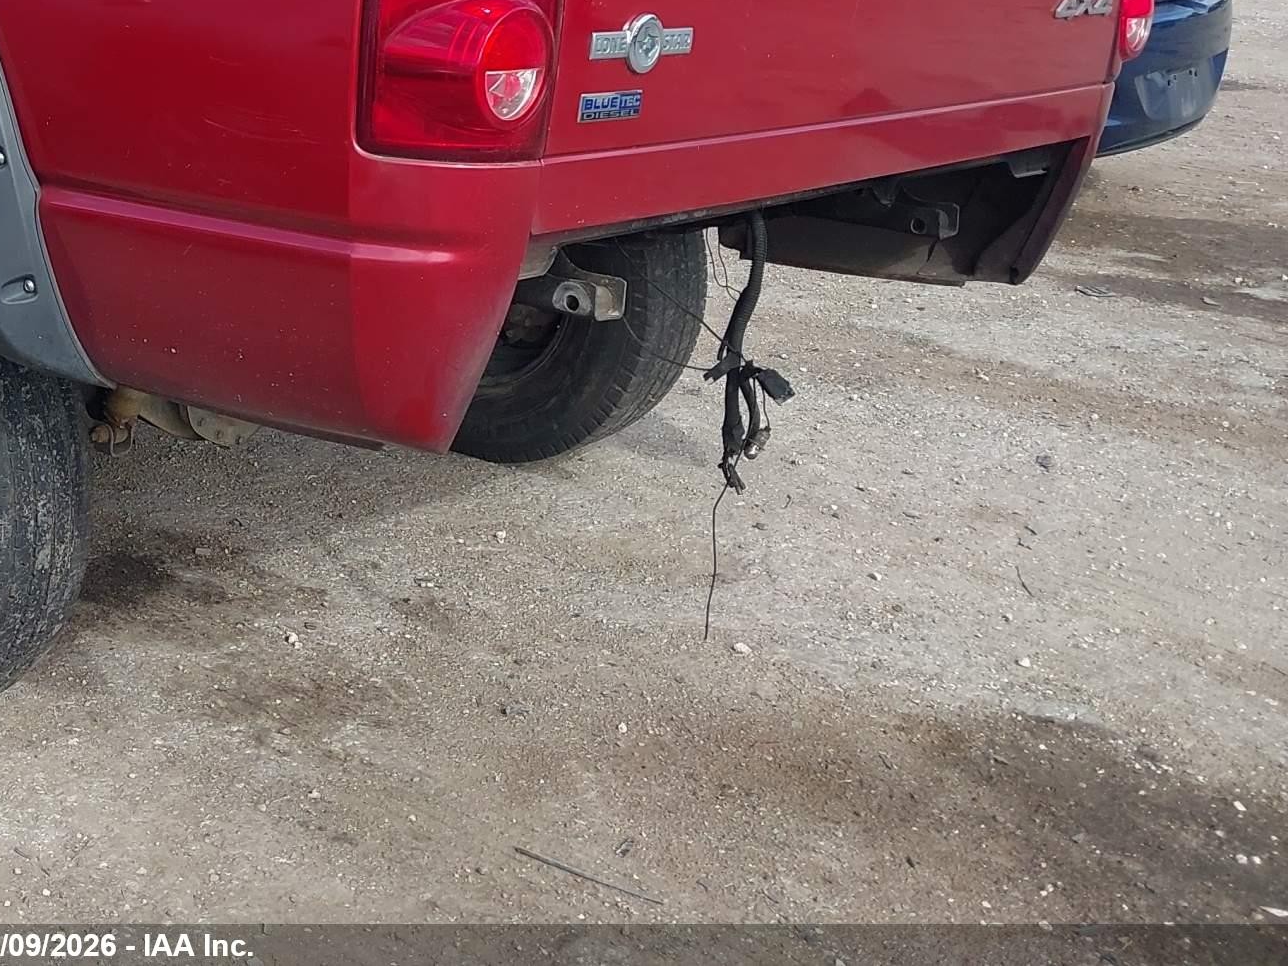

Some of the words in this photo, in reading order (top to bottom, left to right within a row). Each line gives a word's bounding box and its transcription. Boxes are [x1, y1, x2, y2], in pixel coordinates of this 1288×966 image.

[595, 36, 627, 54] LONE
[661, 33, 691, 51] STAR
[582, 109, 640, 120] DIESEL
